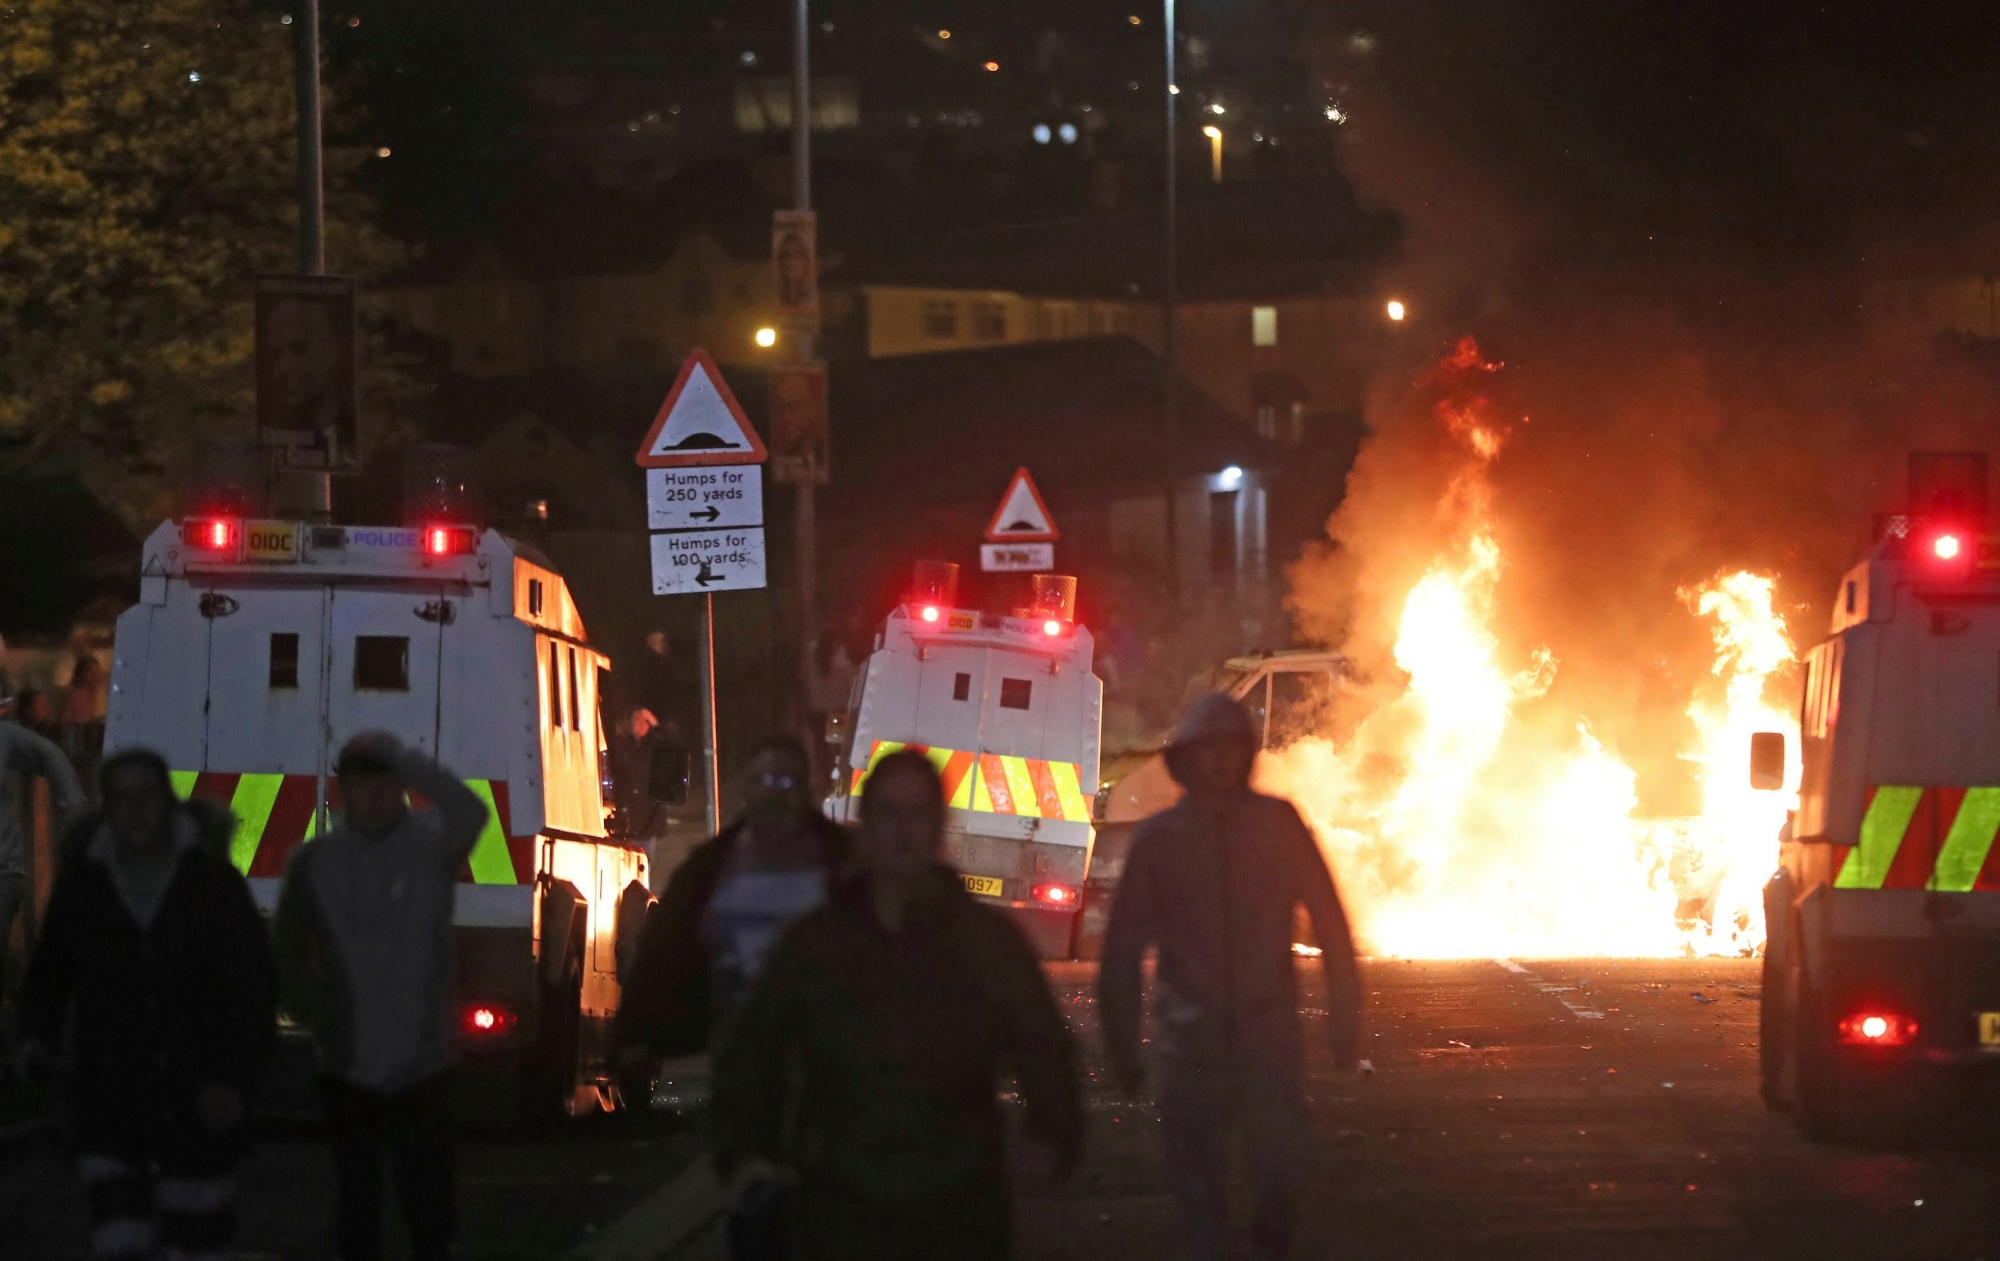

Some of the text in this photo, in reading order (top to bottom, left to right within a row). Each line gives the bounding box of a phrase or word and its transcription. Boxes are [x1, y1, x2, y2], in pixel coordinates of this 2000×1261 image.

[665, 471, 744, 486] Humps for
[667, 488, 744, 502] 250 yards
[353, 532, 417, 546] POLICE
[669, 535, 747, 550] Humps for
[672, 551, 746, 566] 100 yards
